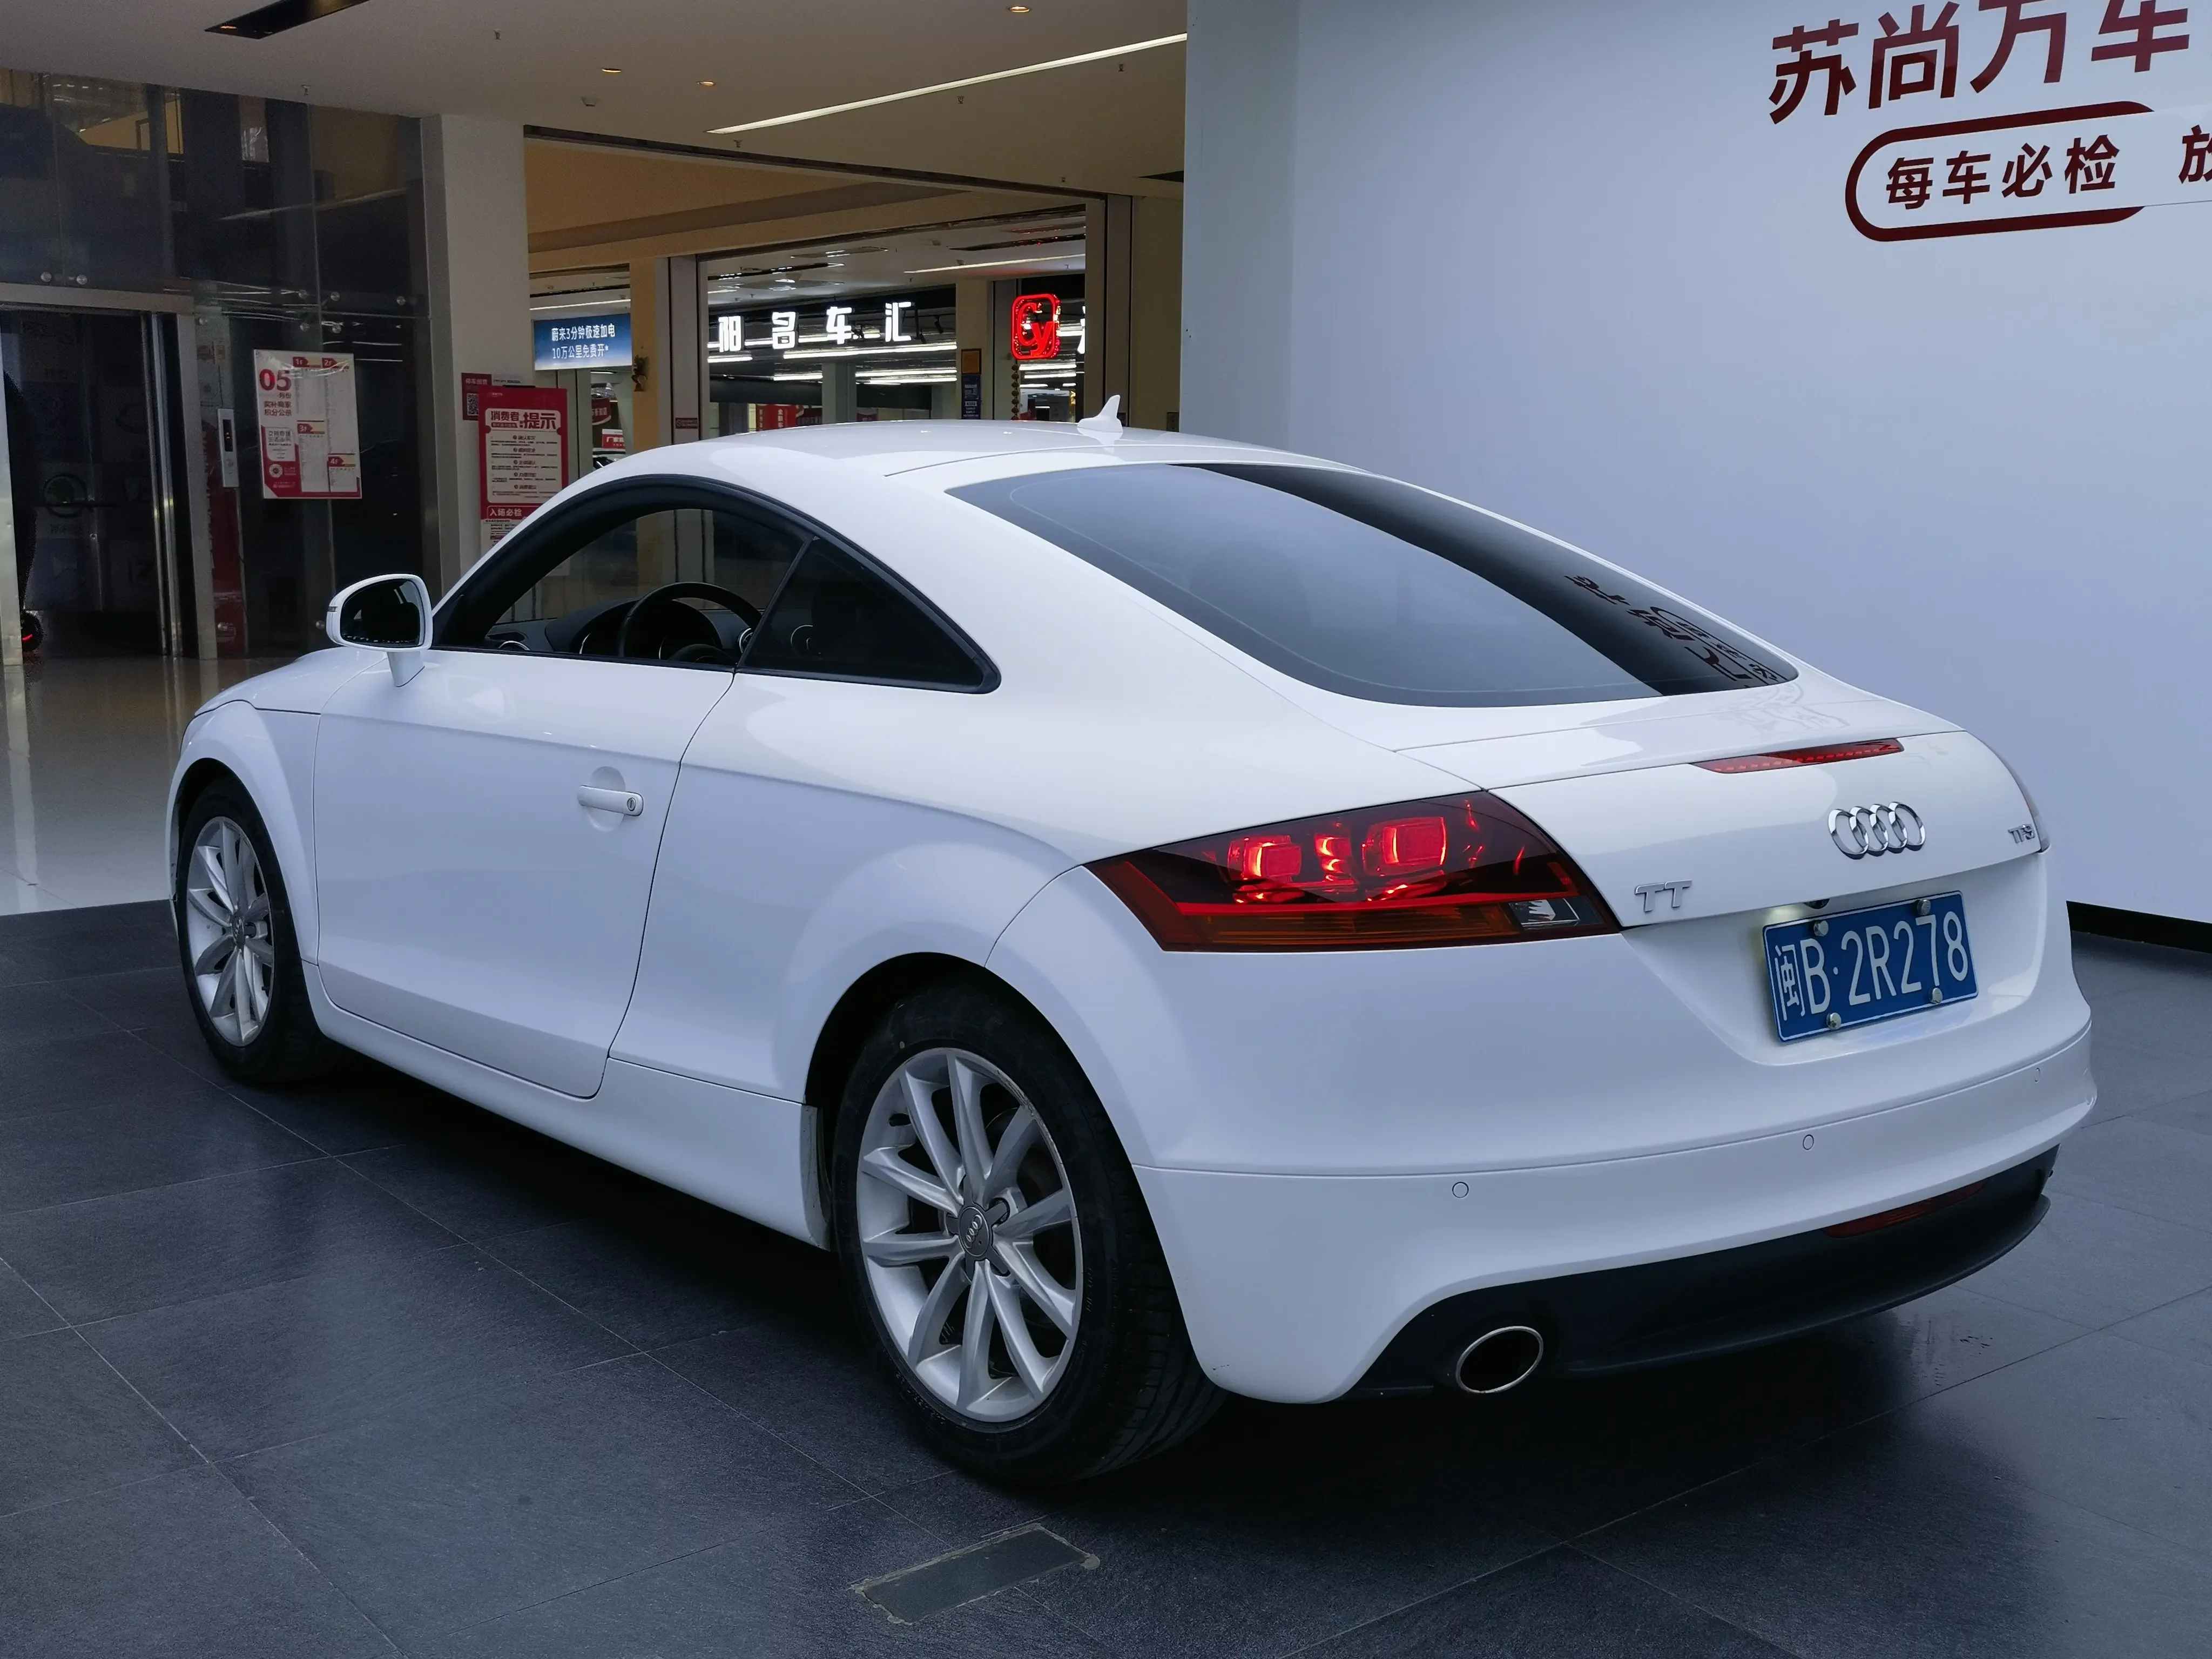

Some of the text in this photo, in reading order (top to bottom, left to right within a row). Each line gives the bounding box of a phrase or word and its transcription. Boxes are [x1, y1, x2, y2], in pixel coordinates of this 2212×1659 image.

[1769, 0, 2190, 124] 苏尚万车
[1885, 134, 2120, 210] 每车必检
[551, 323, 616, 341] 蔚来3分钟极速加电
[259, 368, 292, 391] 05
[491, 410, 520, 421] 消费者
[489, 508, 522, 517] 入场必检
[1635, 879, 1692, 913] TT
